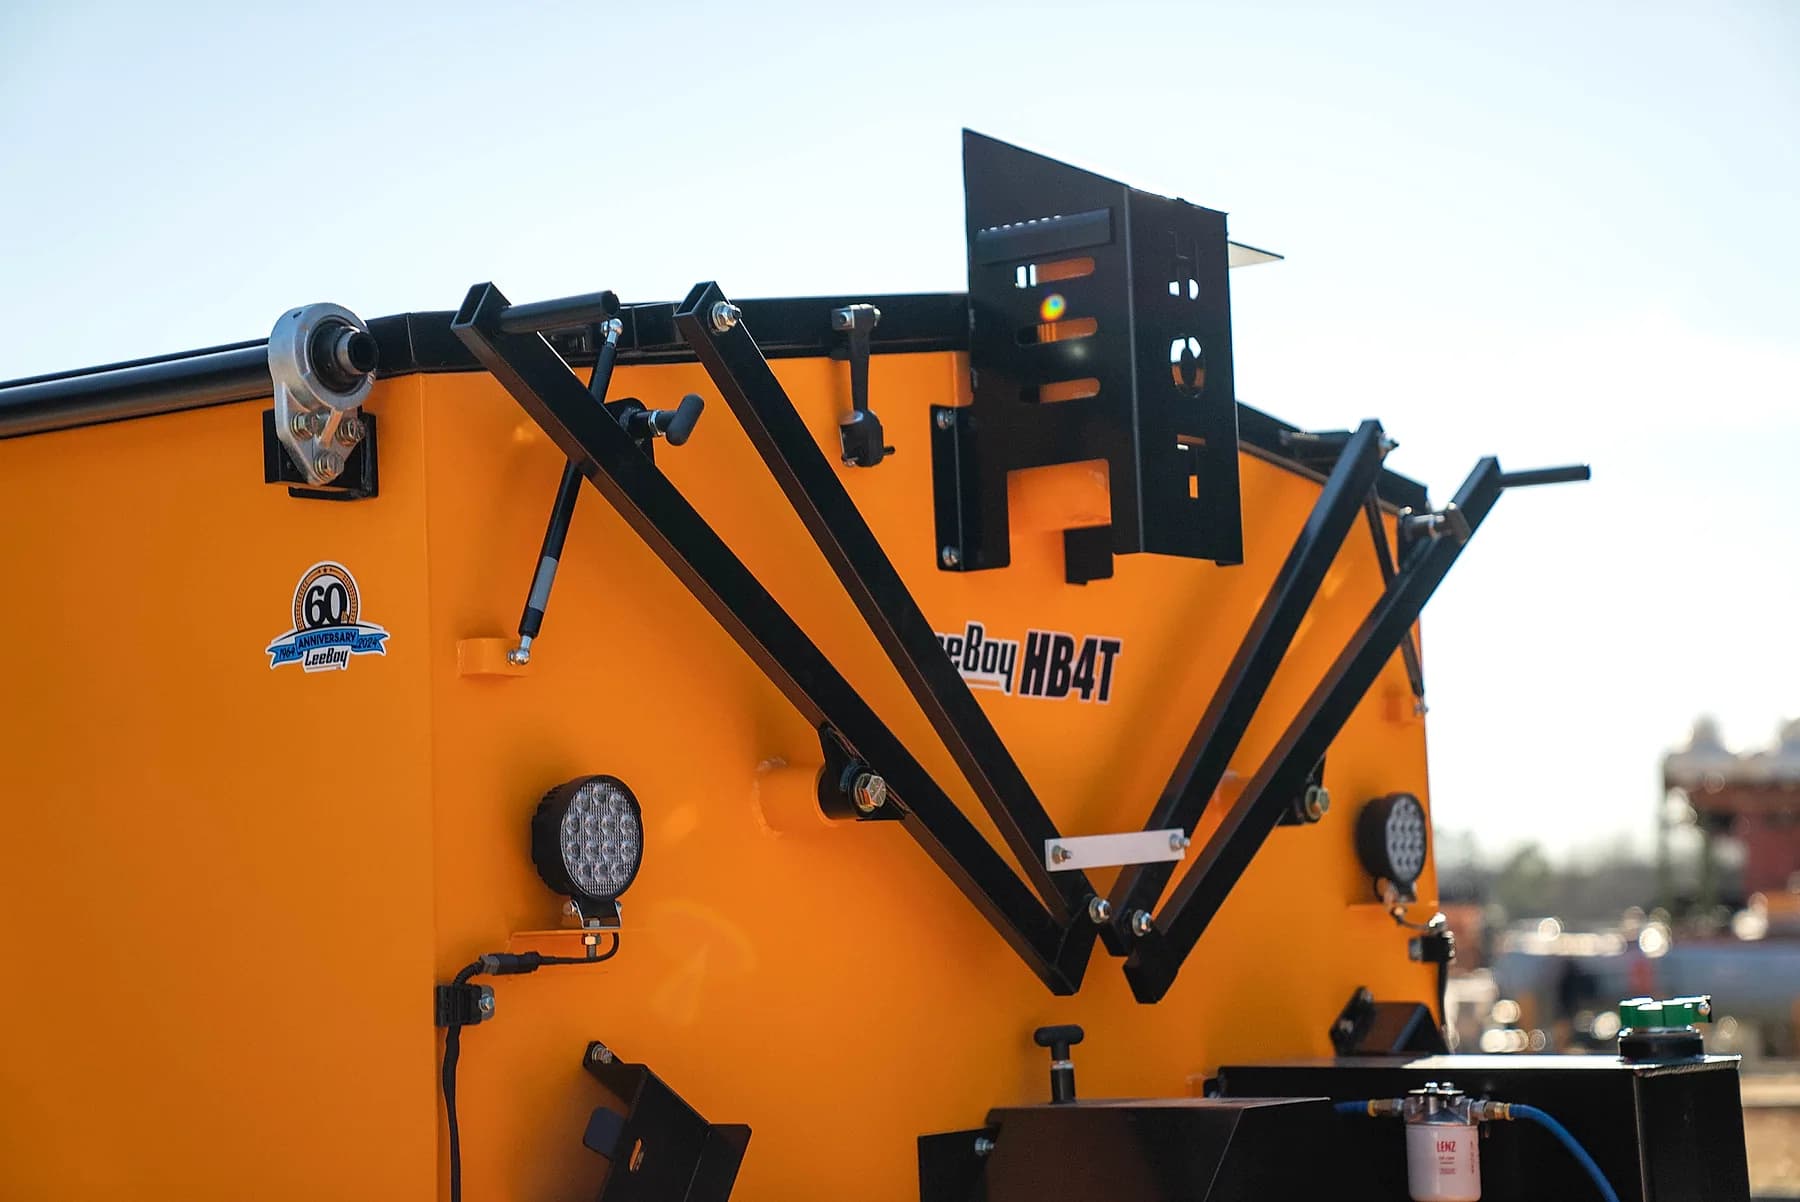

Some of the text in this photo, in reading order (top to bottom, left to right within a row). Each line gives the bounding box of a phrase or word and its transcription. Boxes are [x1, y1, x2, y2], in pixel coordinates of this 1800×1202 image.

[299, 631, 356, 649] ANNIVERSARY
[358, 637, 377, 649] 2024
[305, 648, 348, 668] LeeBoy
[936, 624, 1121, 702] eBoy HB4T
[1436, 1141, 1456, 1153] LENZ
